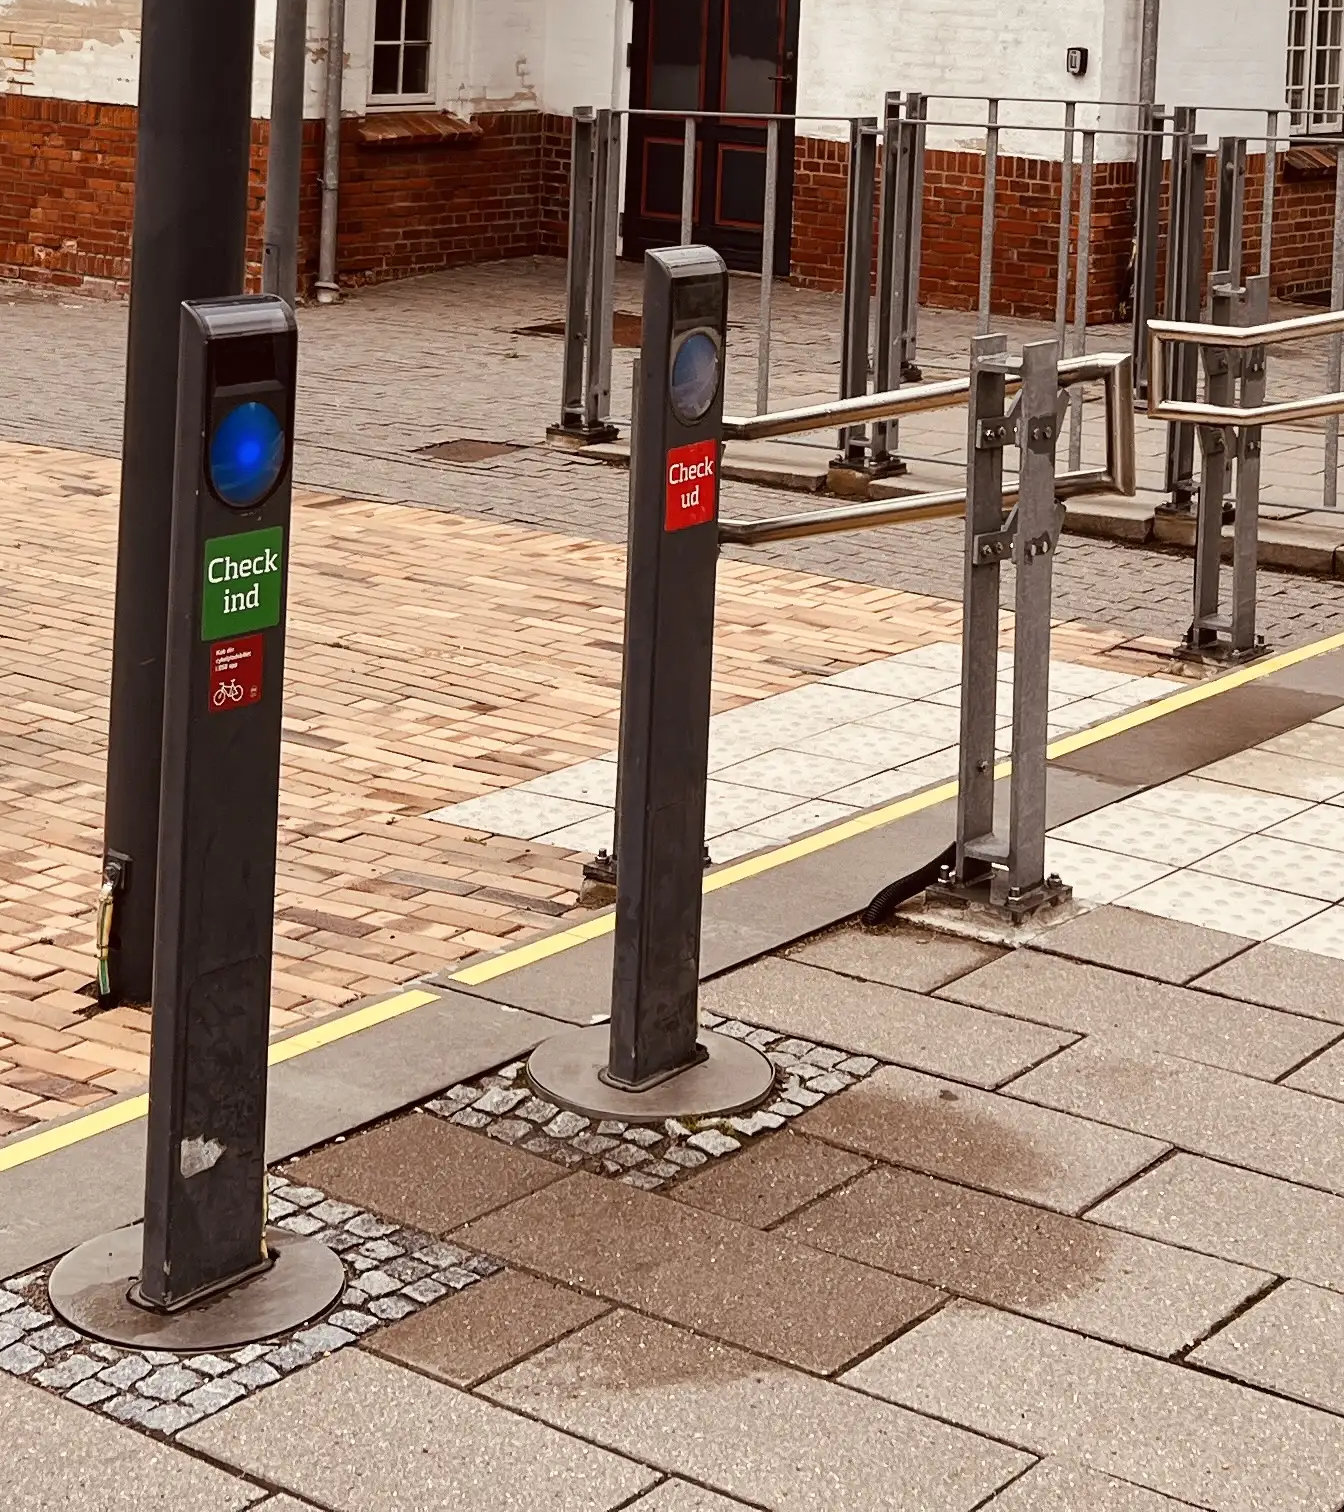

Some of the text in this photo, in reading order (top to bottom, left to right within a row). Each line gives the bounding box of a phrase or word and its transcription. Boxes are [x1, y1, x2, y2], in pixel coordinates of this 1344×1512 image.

[669, 456, 714, 485] Check
[681, 485, 700, 508] ud
[208, 548, 278, 583] Check
[223, 583, 260, 614] ind
